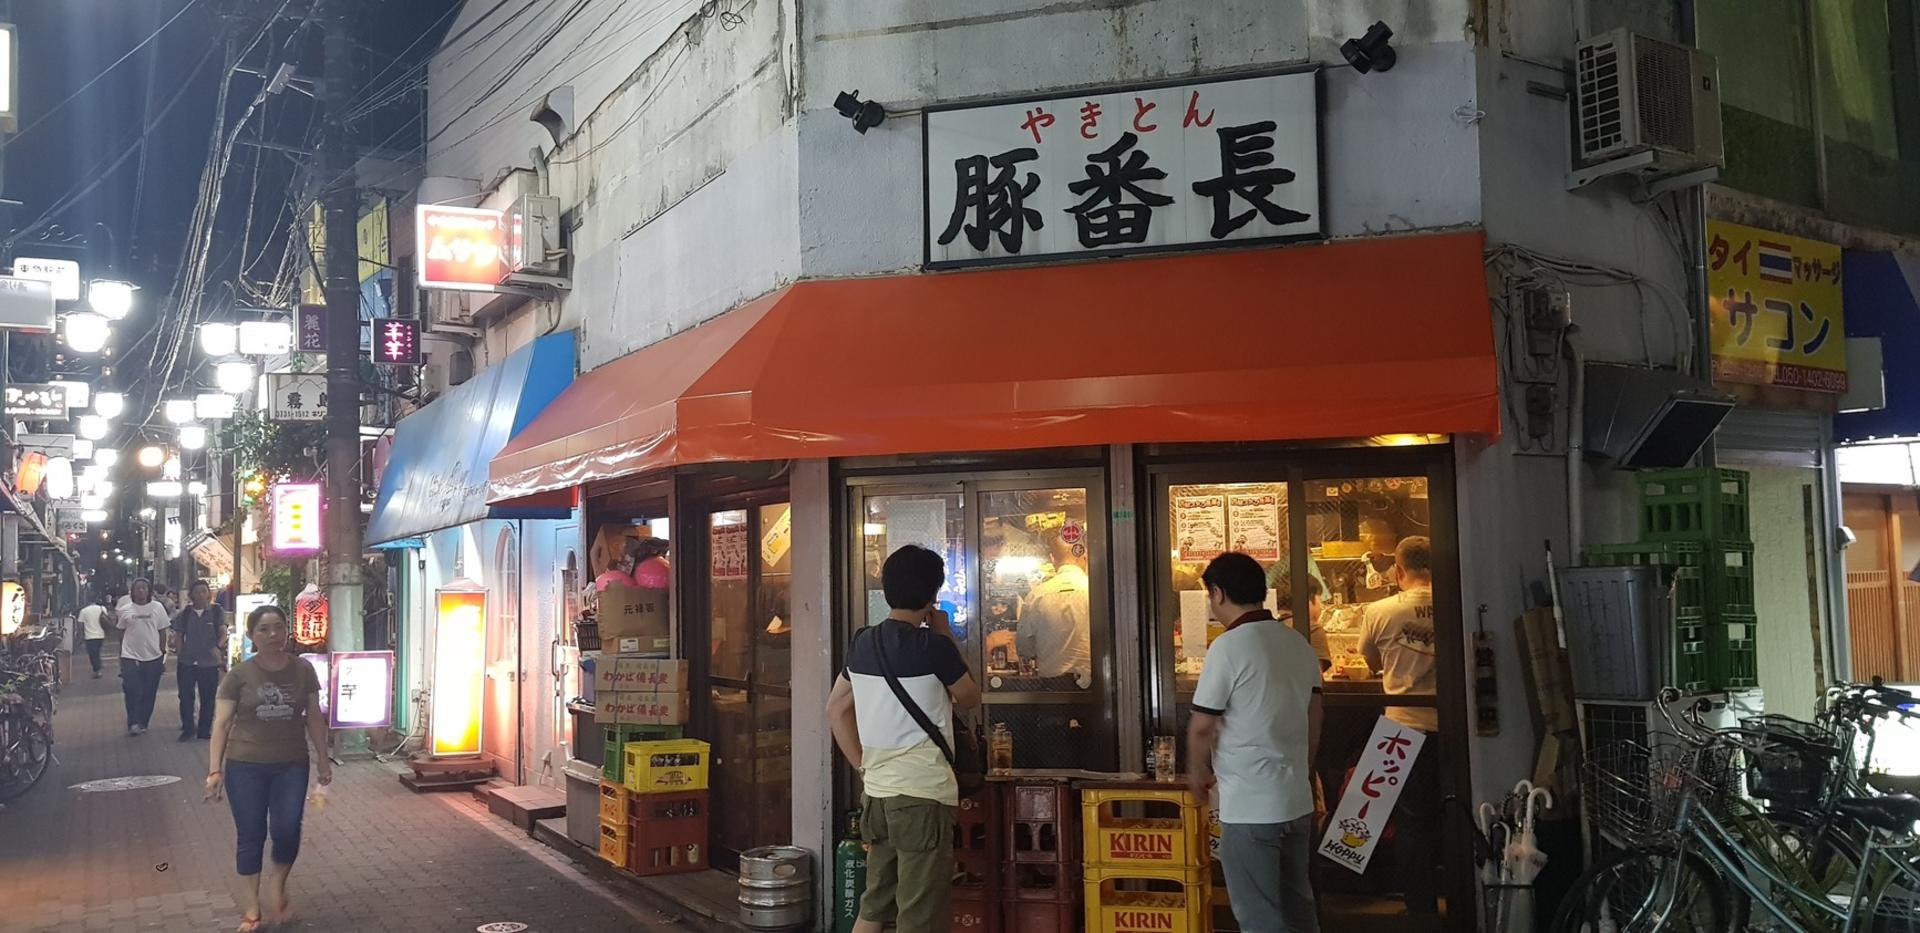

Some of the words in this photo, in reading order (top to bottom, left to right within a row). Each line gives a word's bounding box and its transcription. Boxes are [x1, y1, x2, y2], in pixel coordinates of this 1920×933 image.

[1020, 90, 1215, 143] やきとん
[937, 120, 1311, 254] 豚番長
[1709, 233, 1752, 276] タイ
[1793, 256, 1841, 286] マッサージ
[303, 314, 321, 348] 麗花
[1722, 287, 1830, 355] サコン
[1360, 729, 1412, 820] ホッピー
[1110, 832, 1172, 851] KIRIN
[1325, 839, 1366, 865] Hoppy
[1115, 911, 1172, 929] KIRIN
